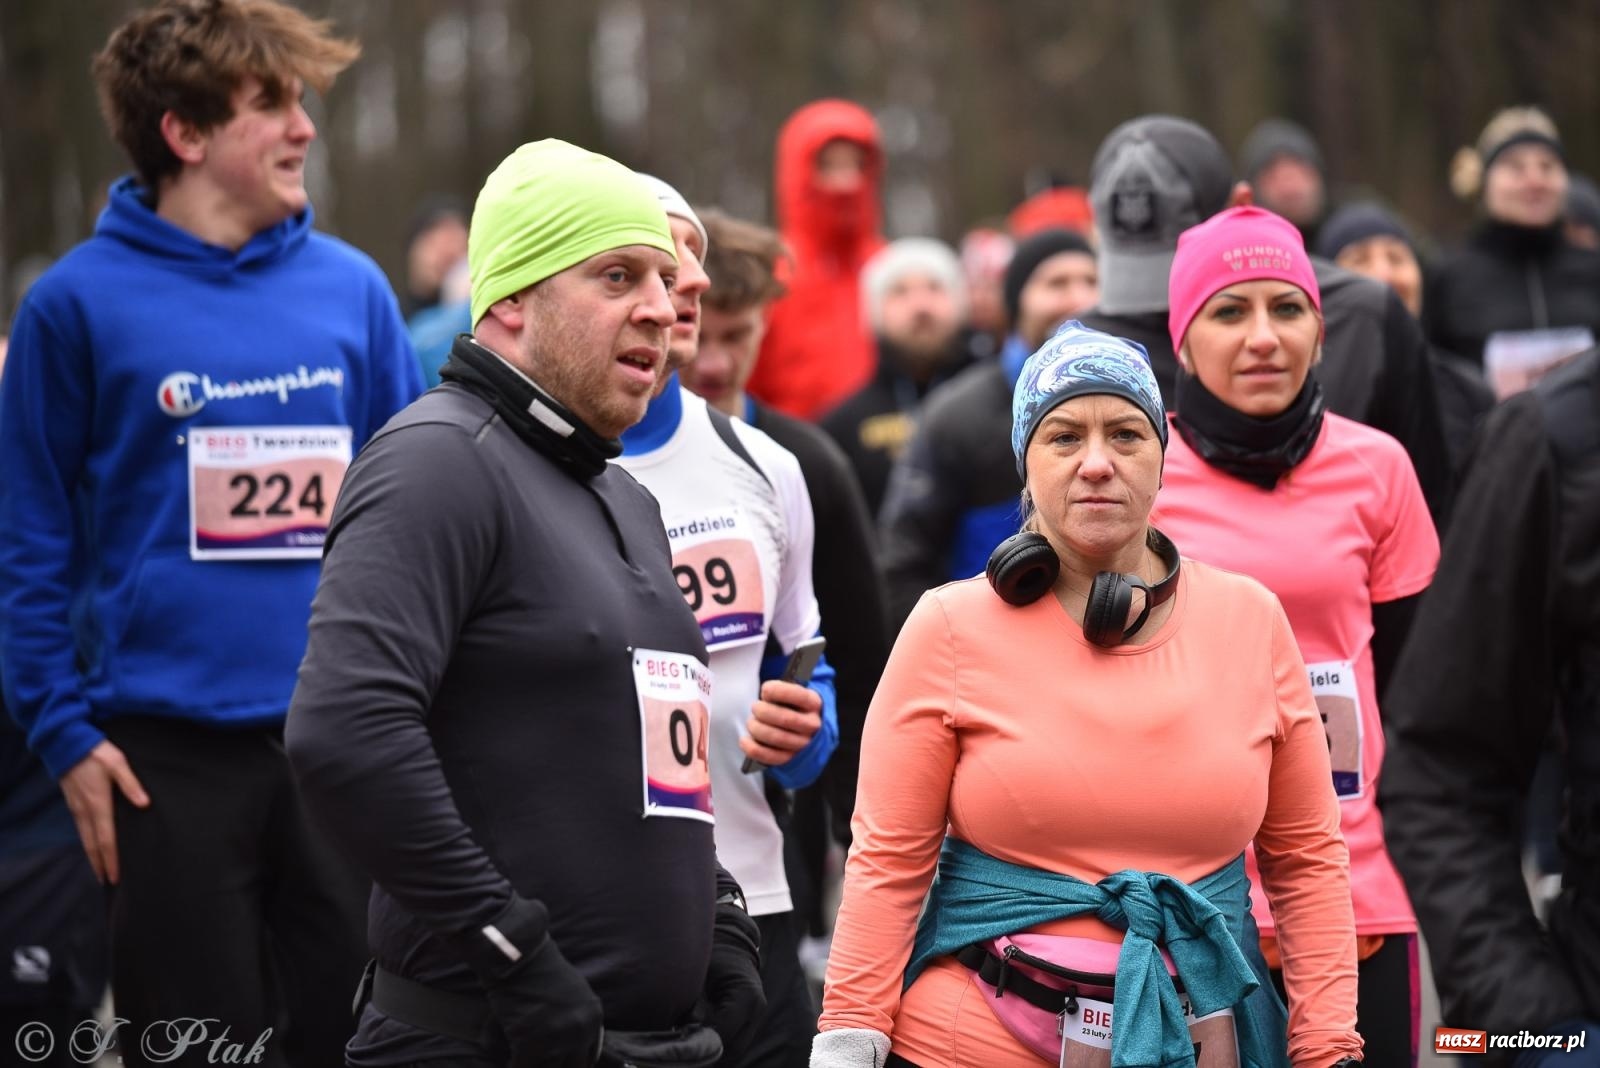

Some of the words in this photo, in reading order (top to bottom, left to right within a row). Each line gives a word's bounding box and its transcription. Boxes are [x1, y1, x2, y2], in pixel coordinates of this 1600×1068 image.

[229, 472, 326, 517] 224
[667, 516, 736, 539] ardziela
[646, 660, 680, 678] BIEG
[1310, 671, 1340, 687] iela
[1083, 1008, 1111, 1028] BIE
[1091, 1029, 1107, 1040] luty
